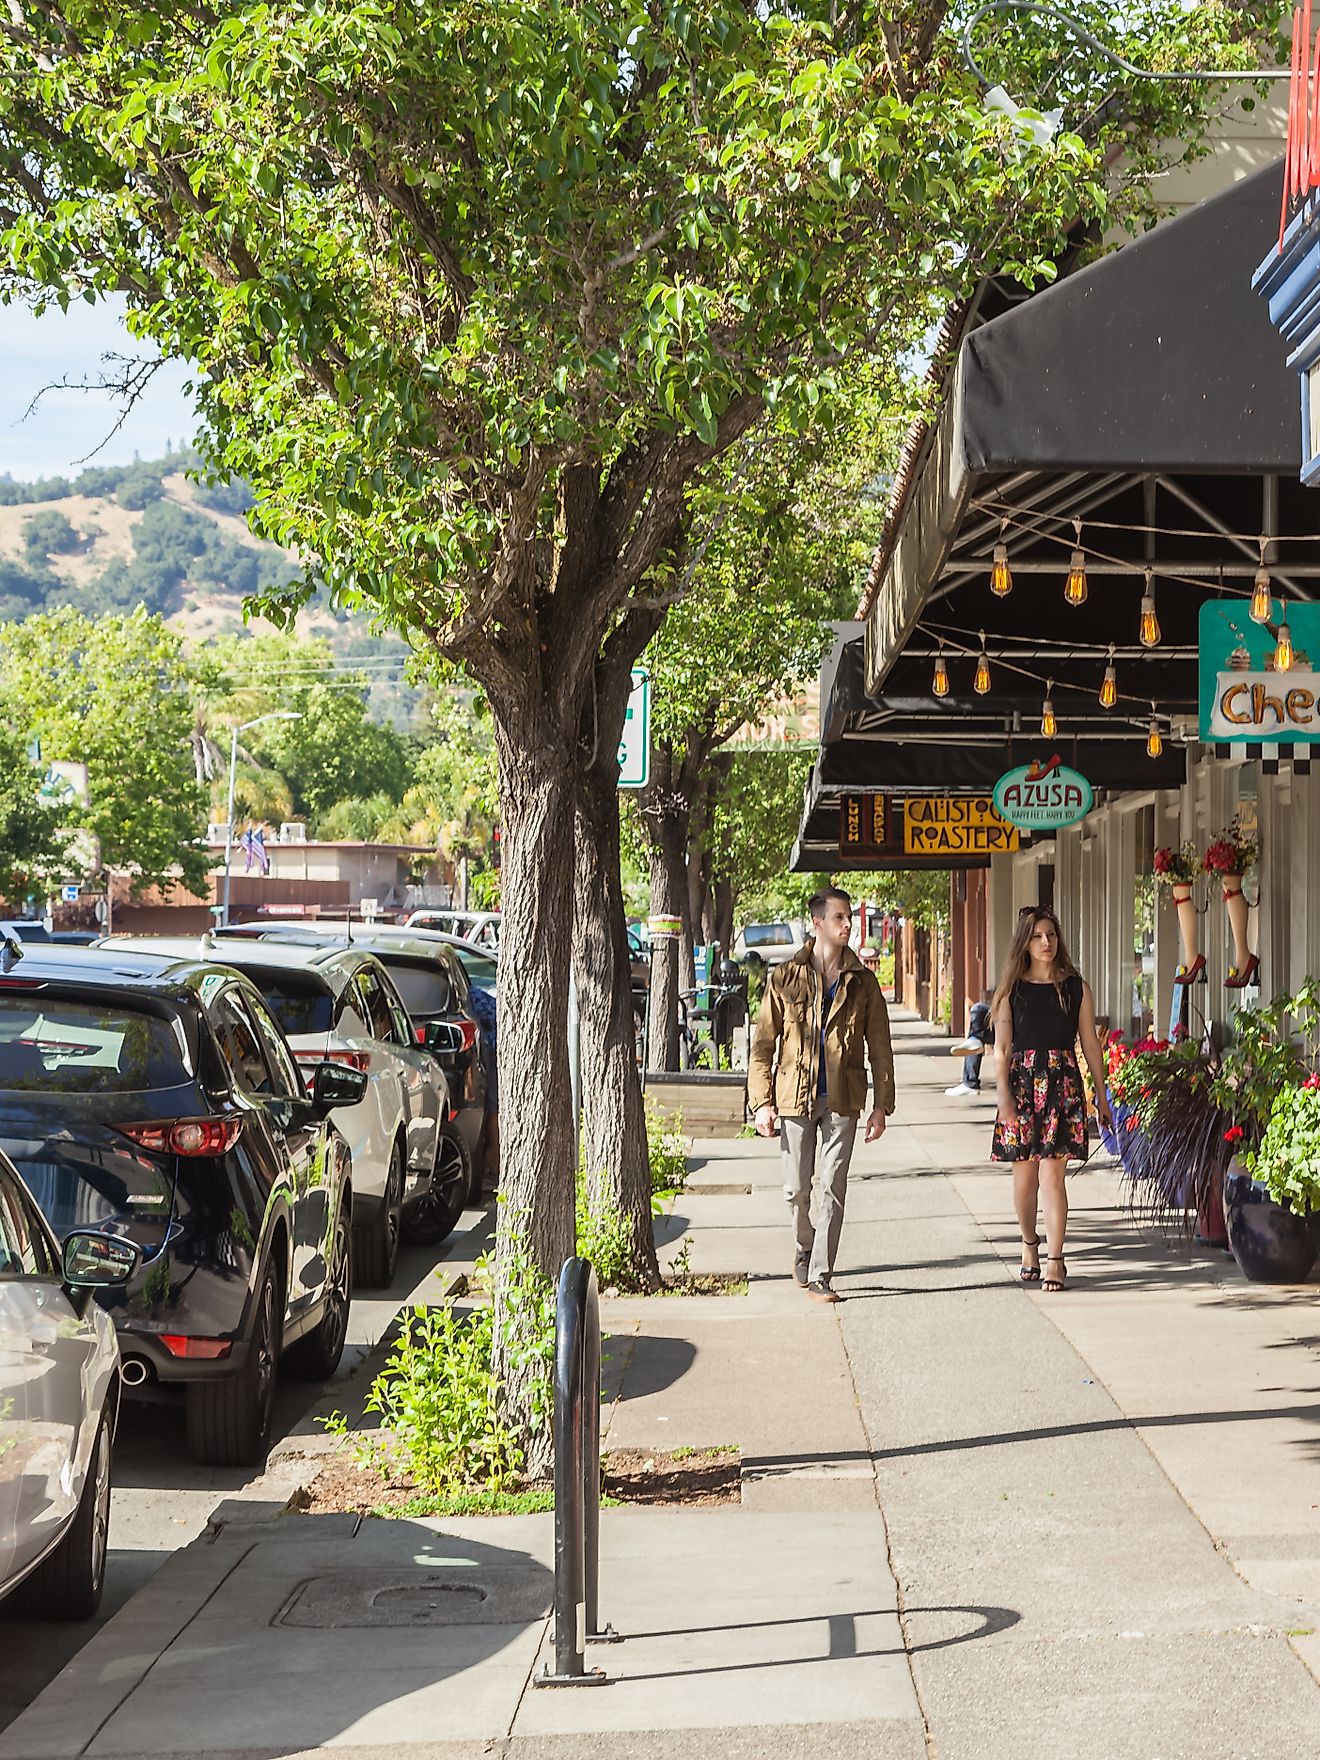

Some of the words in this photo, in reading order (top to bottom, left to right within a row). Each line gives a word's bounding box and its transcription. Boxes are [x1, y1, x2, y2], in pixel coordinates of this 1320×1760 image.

[1003, 784, 1083, 808] AZUSA
[907, 800, 1007, 823] CALISTOG
[1011, 810, 1029, 820] HAPPY
[1046, 810, 1063, 820] HAPPY
[911, 826, 1015, 849] ROASTERY
